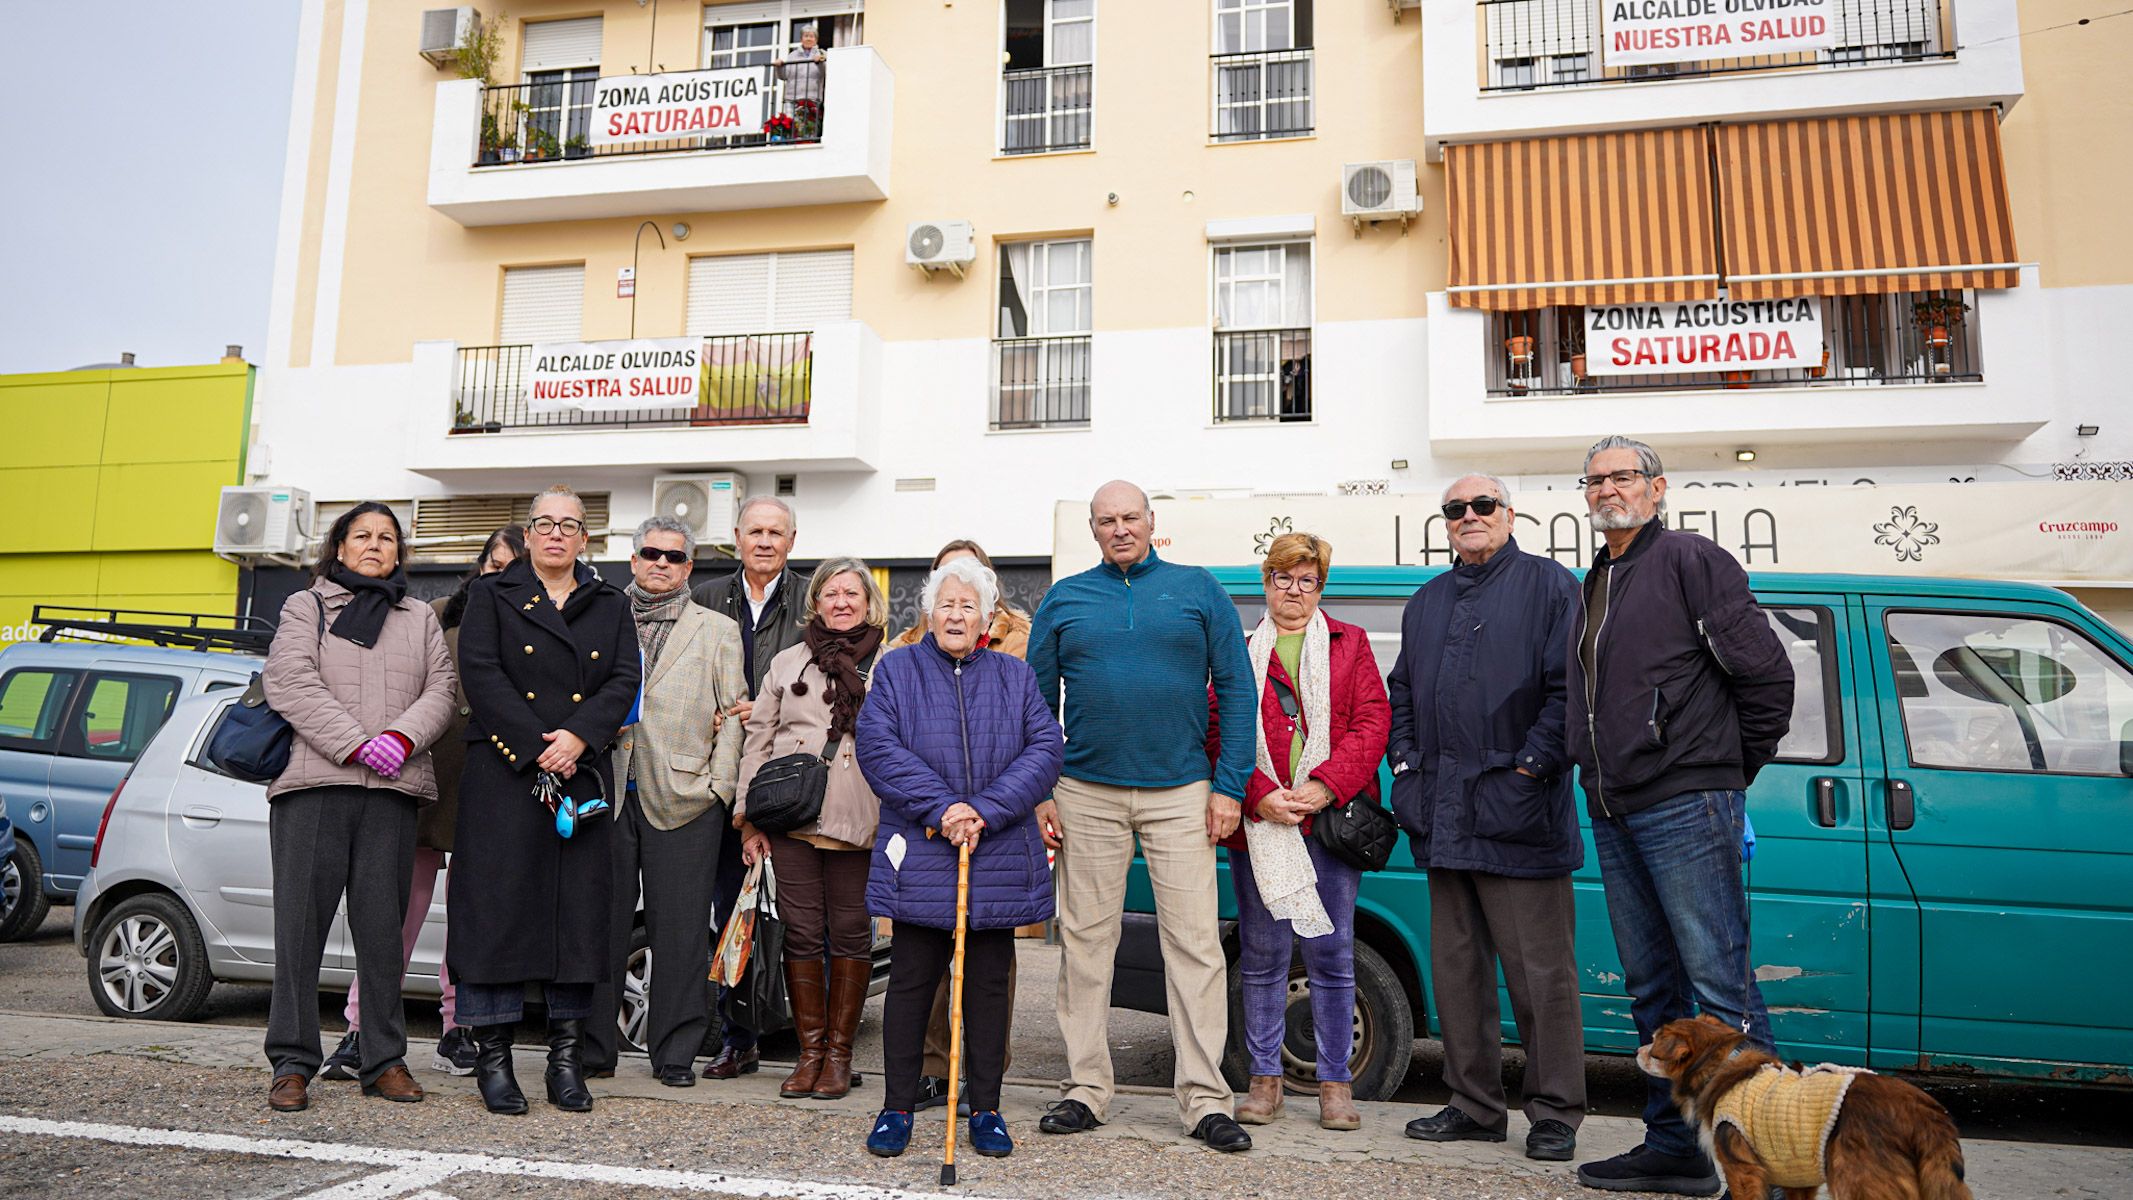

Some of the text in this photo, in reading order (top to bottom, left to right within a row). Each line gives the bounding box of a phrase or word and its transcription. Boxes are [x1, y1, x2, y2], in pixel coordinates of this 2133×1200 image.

[1613, 0, 1717, 22] ALCALDE
[1614, 15, 1826, 51] NUESTRA SALUD
[598, 77, 758, 108] ZONA ACÚSTICA
[608, 104, 741, 136] SATURADA
[1591, 297, 1815, 331] ZONA ACÚSTICA
[536, 349, 696, 373] ALCALDE OLVIDAS
[1611, 330, 1797, 367] SATURADA
[534, 376, 693, 400] NUESTRA SALUD
[2039, 521, 2118, 534] Cruzcampo
